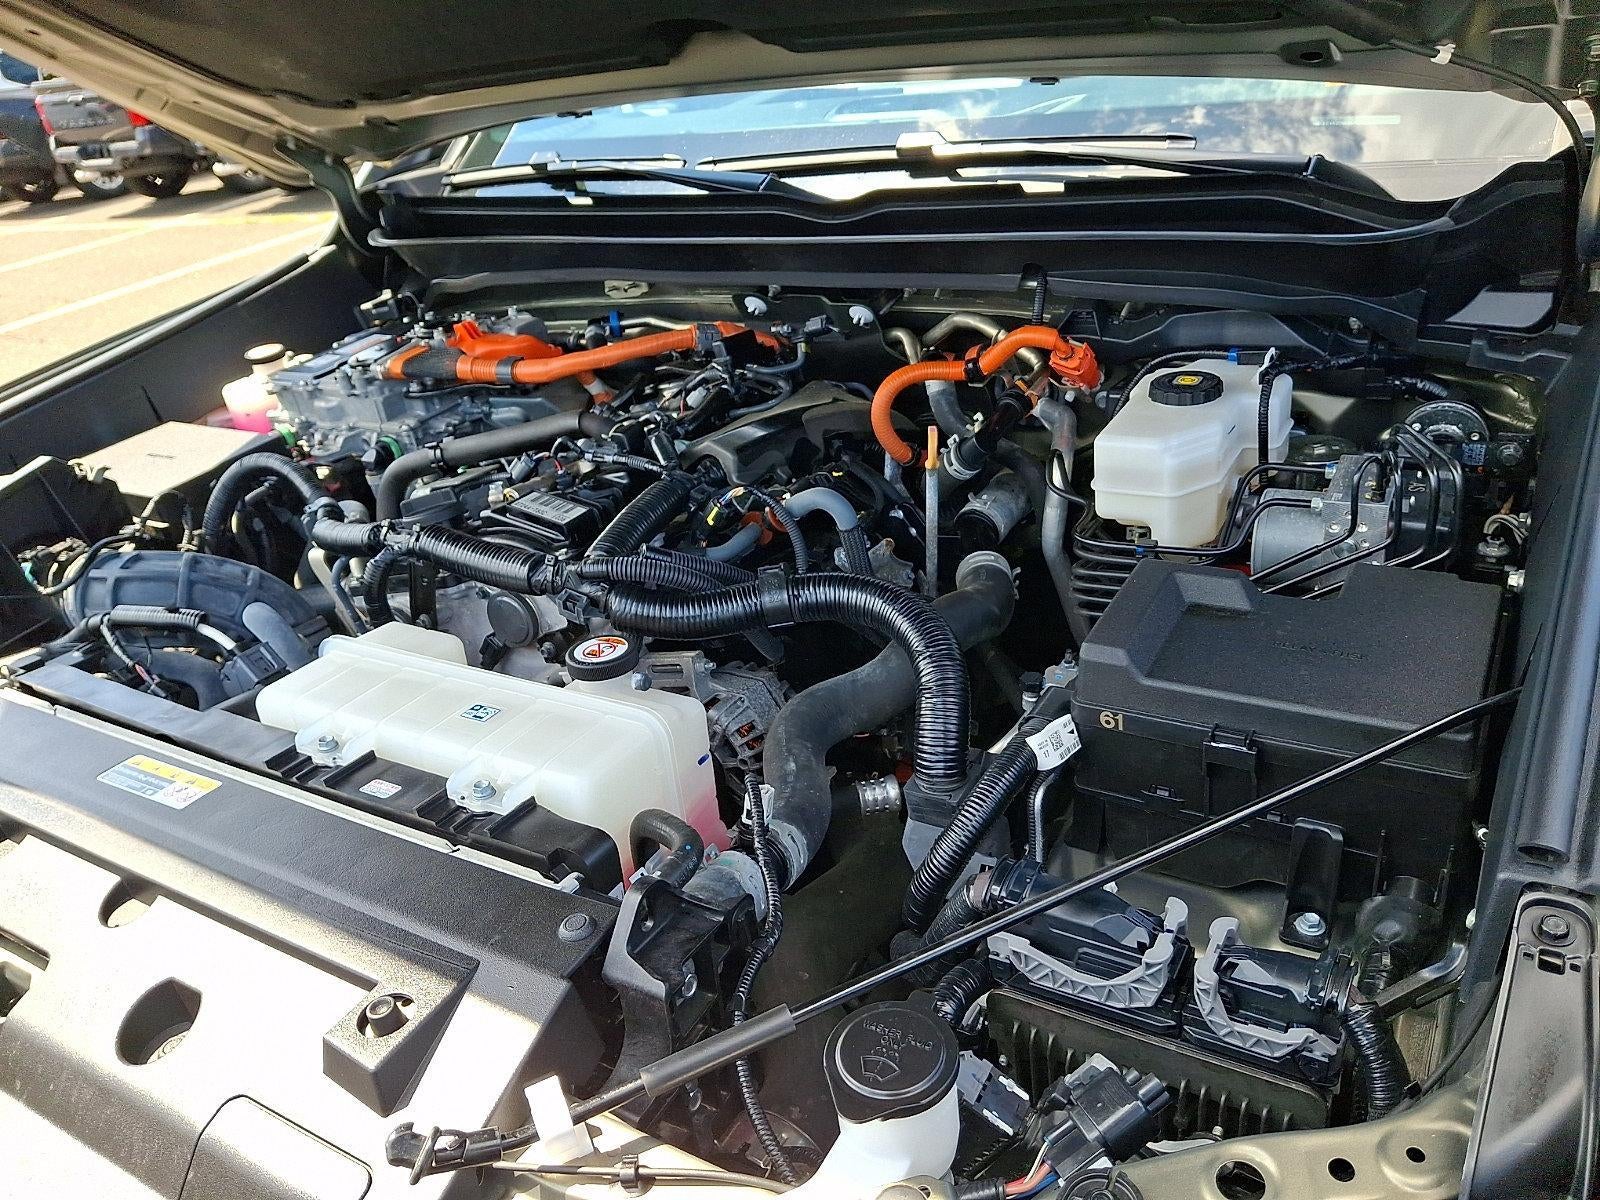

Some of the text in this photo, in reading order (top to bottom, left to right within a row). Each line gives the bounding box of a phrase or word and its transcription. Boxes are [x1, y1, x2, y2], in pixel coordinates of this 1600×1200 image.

[1100, 711, 1123, 731] 61
[863, 1019, 933, 1051] WASHER FLUID
[881, 1035, 906, 1050] ONLY
